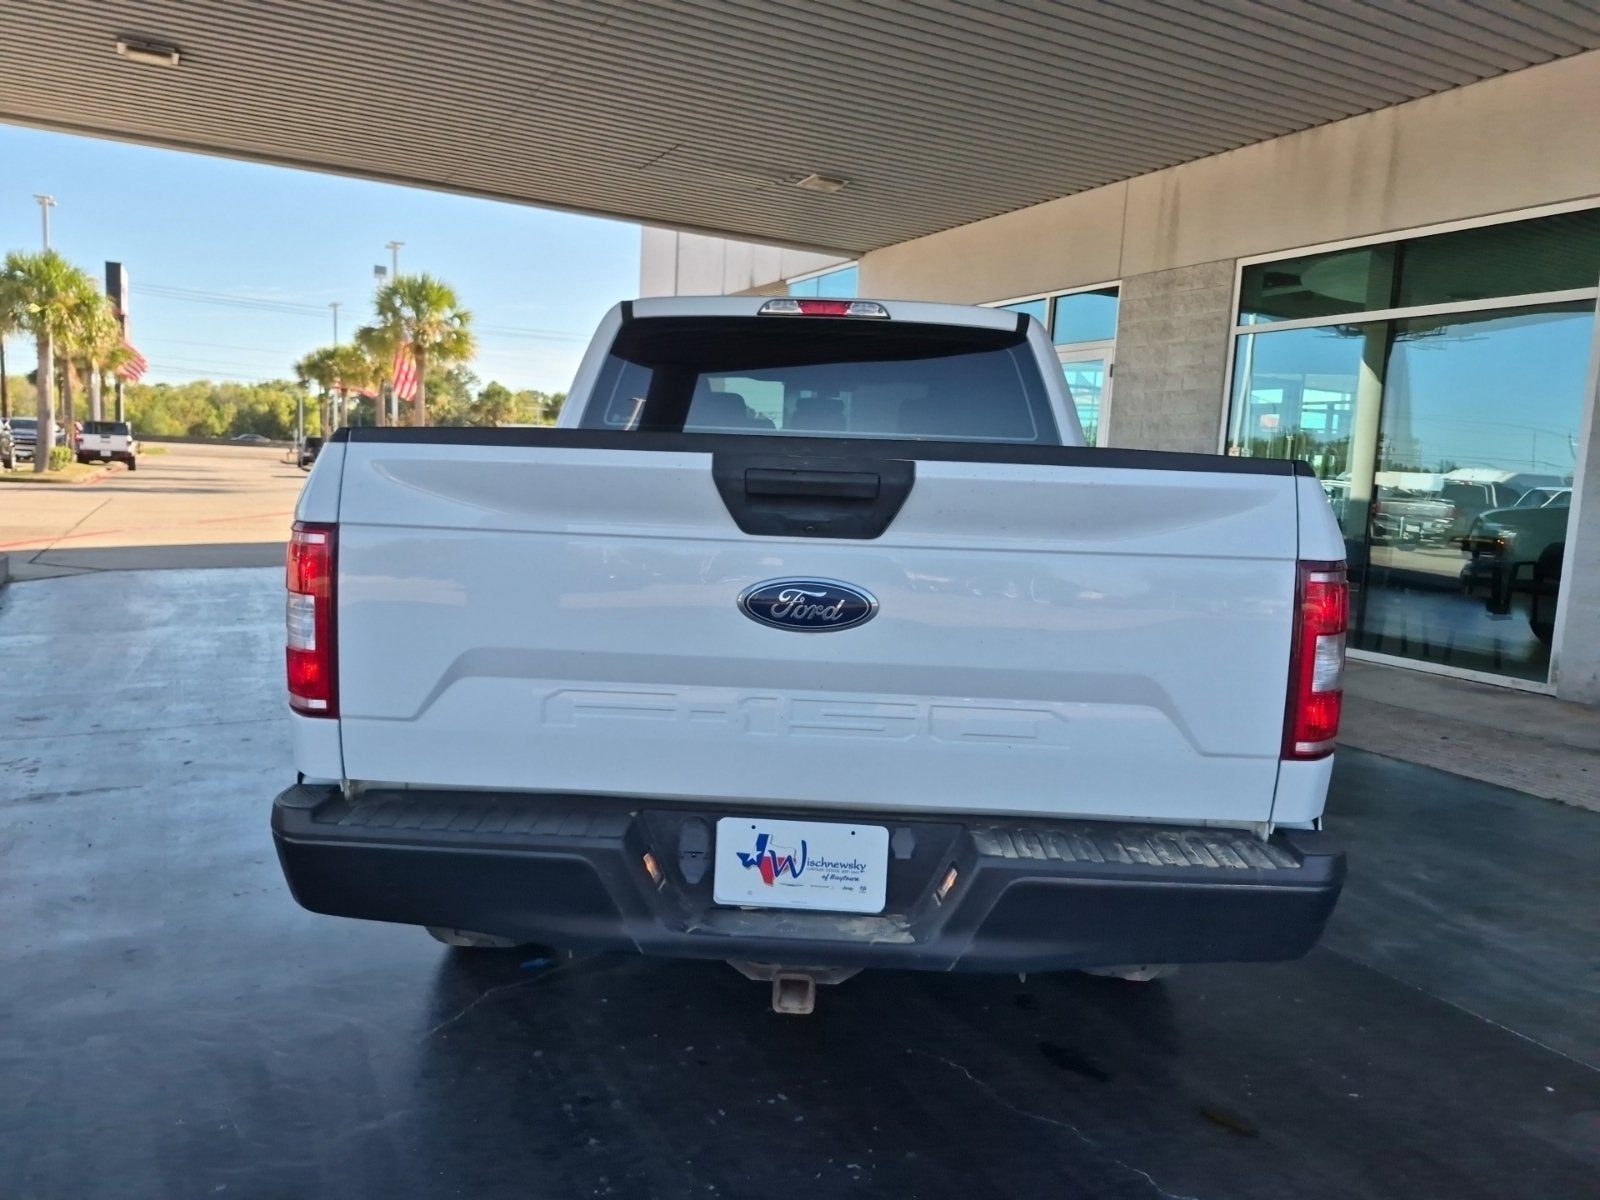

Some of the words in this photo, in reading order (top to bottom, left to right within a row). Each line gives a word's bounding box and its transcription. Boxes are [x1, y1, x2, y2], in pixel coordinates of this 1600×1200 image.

[770, 588, 845, 620] Ford
[540, 688, 1071, 751] F-150
[768, 839, 866, 878] Wischnewsky
